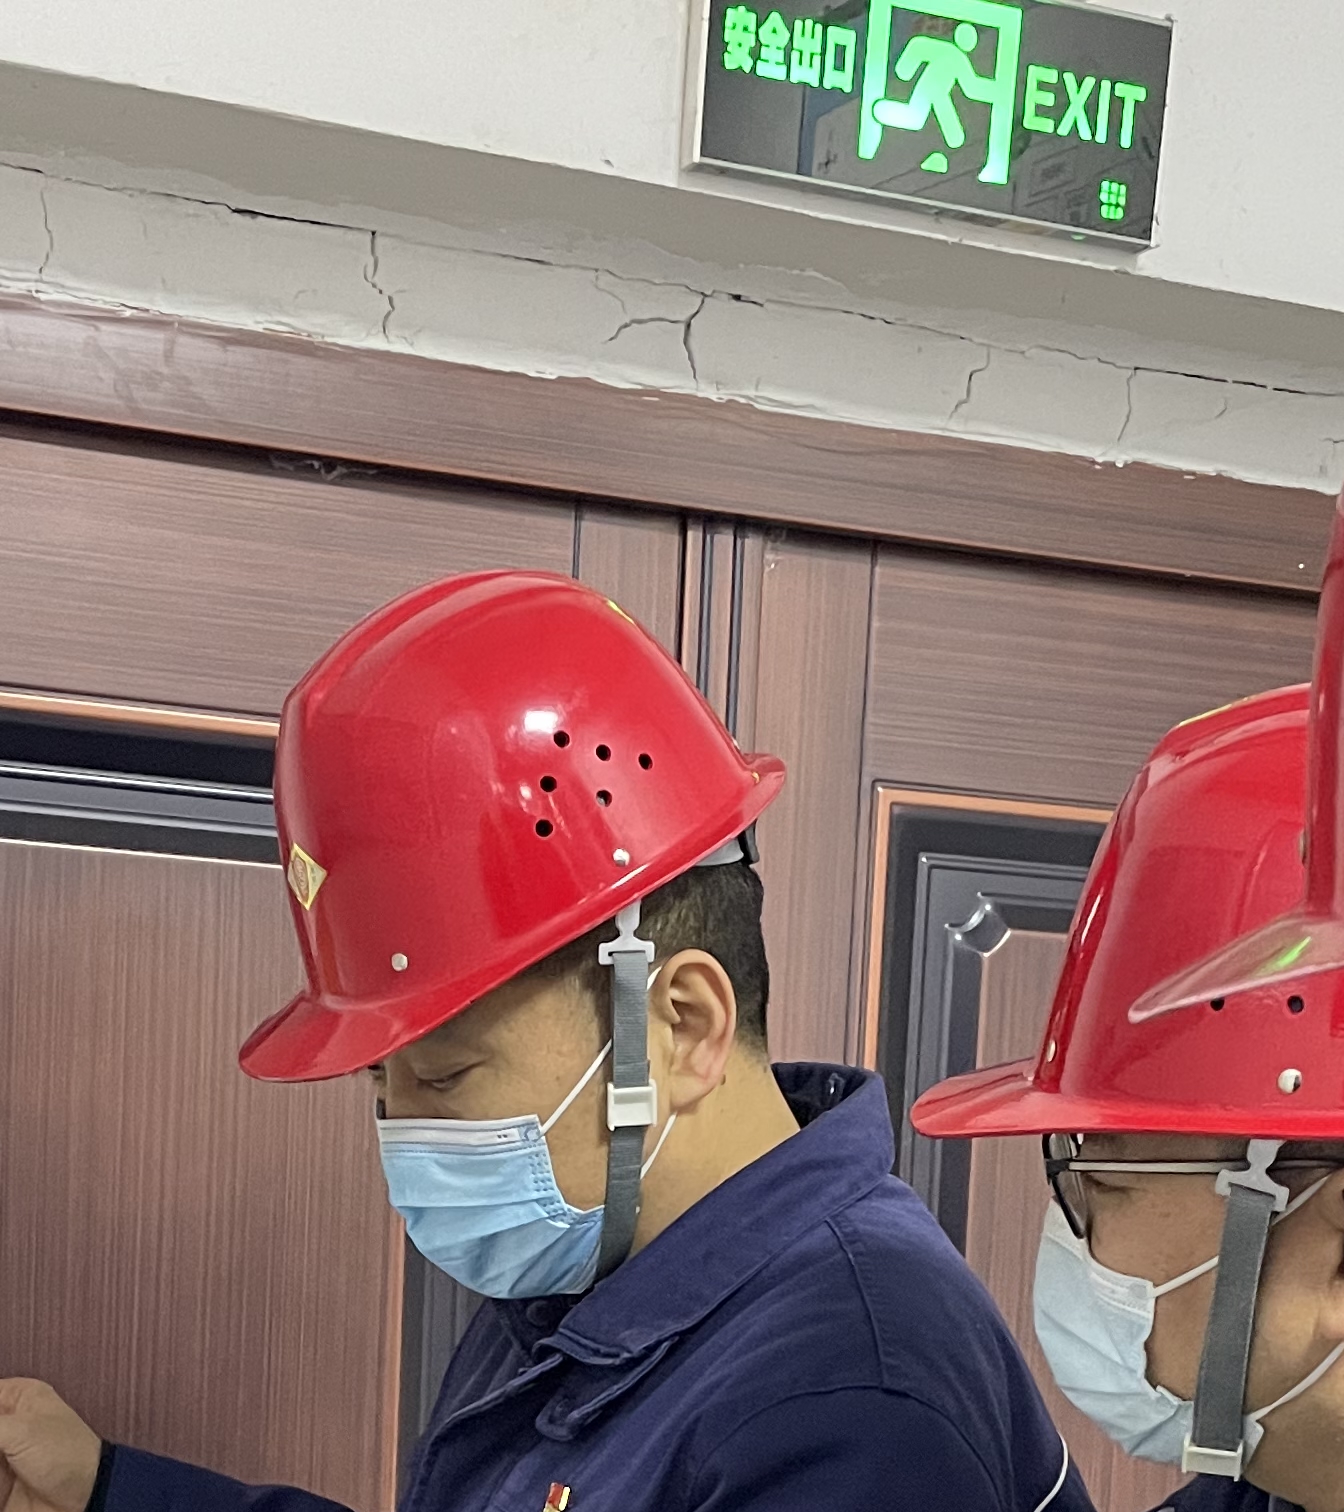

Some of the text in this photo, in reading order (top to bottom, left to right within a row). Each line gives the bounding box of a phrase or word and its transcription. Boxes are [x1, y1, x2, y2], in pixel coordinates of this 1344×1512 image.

[723, 4, 857, 93] 安全出口
[1022, 64, 1147, 149] EXIT
